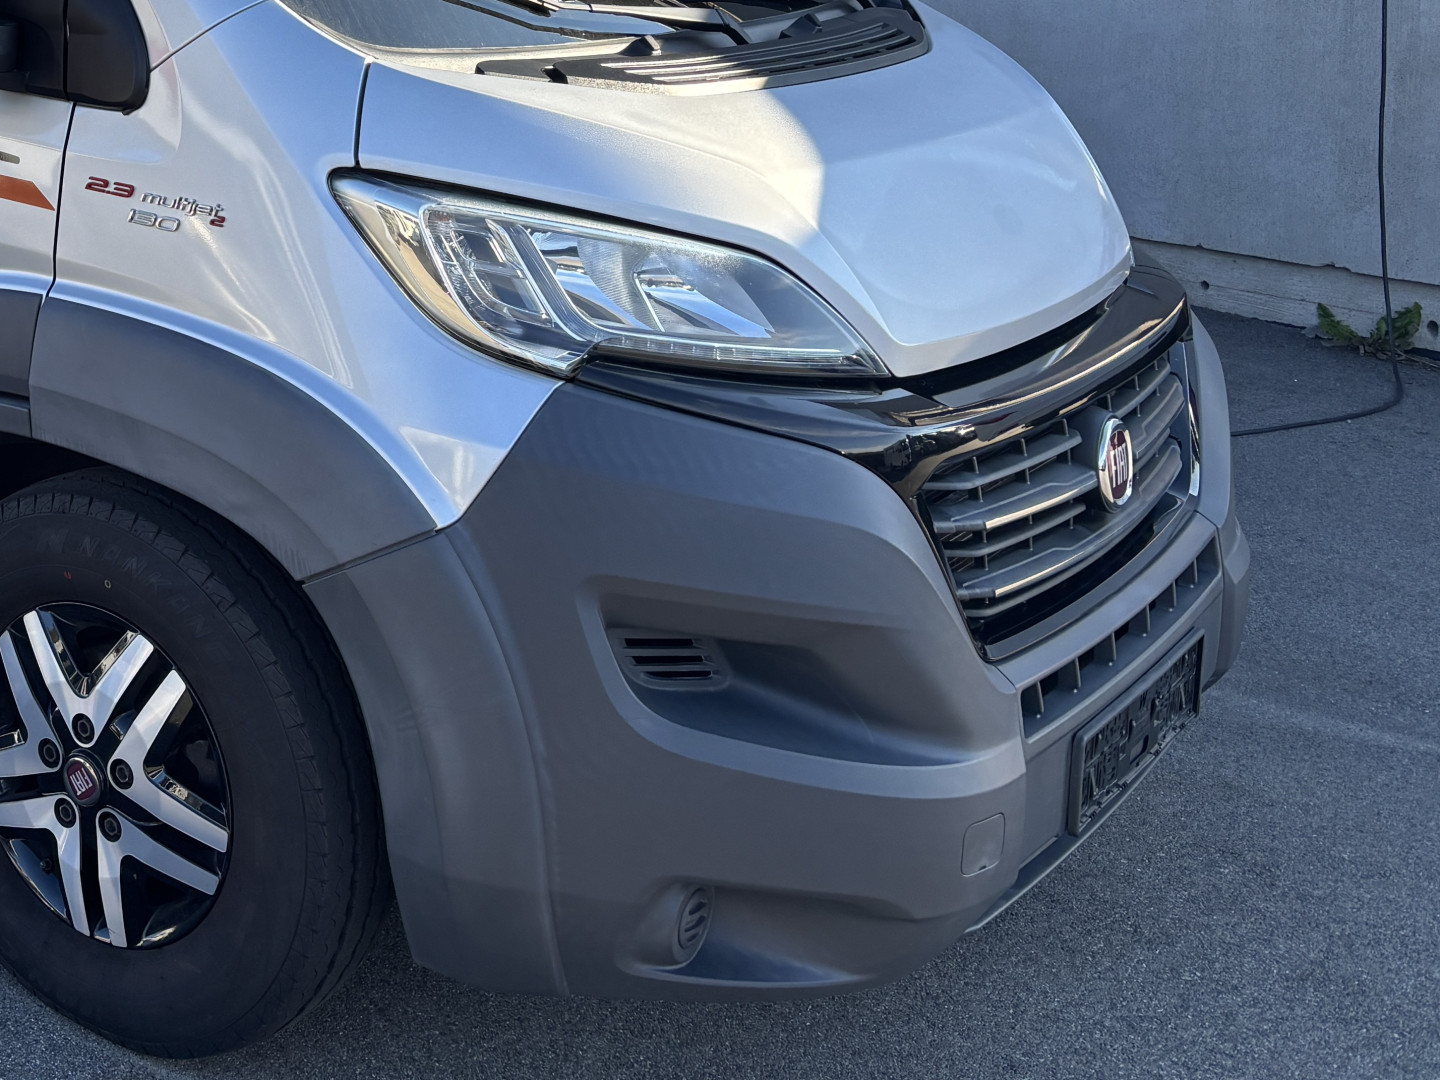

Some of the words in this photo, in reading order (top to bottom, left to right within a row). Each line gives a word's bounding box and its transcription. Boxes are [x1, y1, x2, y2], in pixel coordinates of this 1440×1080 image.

[84, 175, 136, 199] 2.3
[140, 192, 225, 217] multijet
[127, 208, 181, 232] 130
[1110, 442, 1129, 489] FIAT
[69, 767, 93, 796] FIAT
